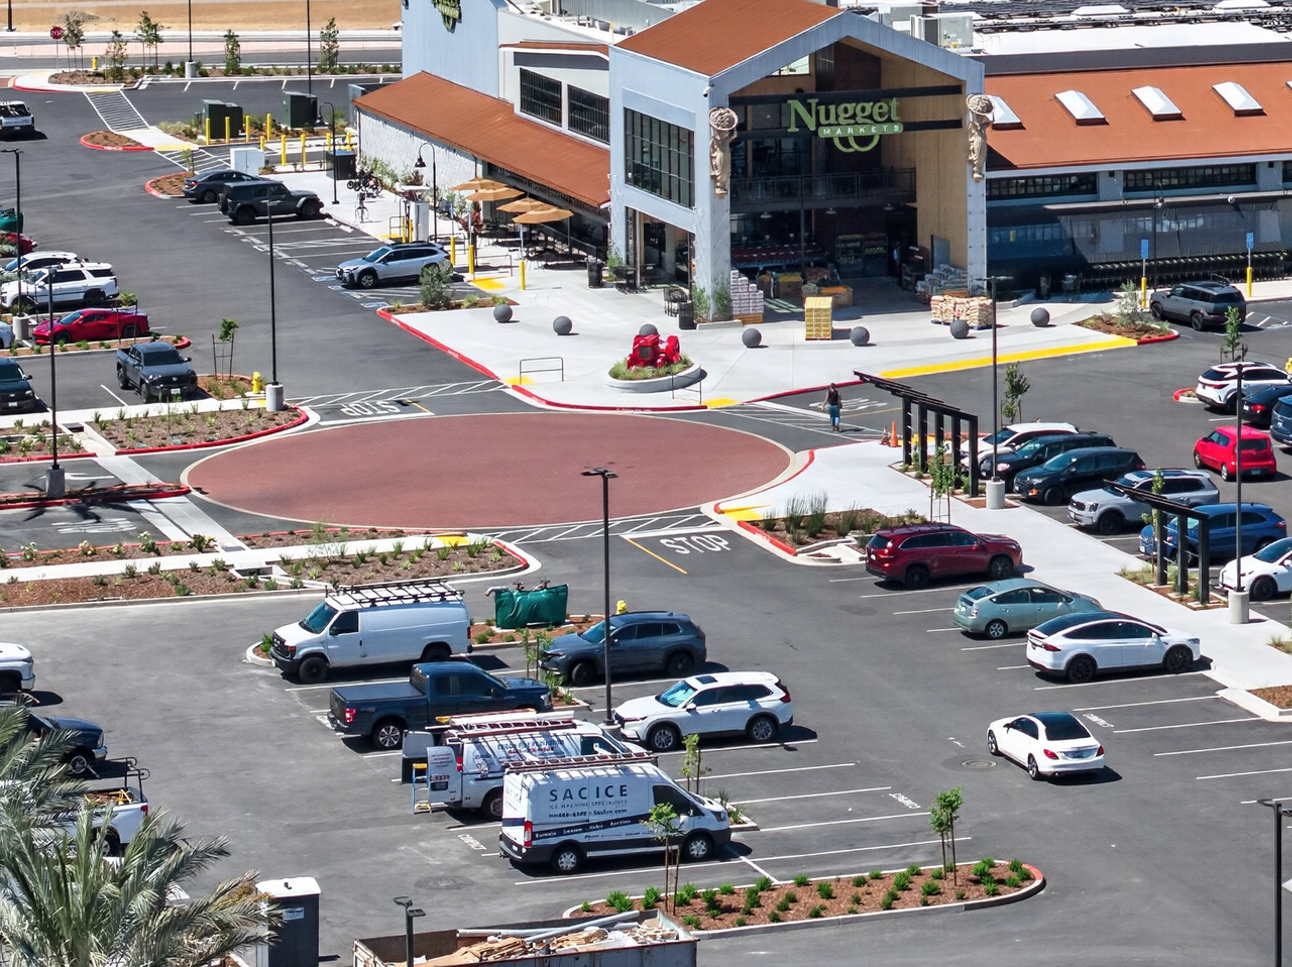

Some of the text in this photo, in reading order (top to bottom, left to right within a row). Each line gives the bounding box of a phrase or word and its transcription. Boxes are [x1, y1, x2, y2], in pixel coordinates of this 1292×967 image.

[787, 97, 900, 132] Nugget
[823, 124, 900, 136] MARKETS
[341, 401, 401, 416] STOP
[660, 534, 731, 555] STOP
